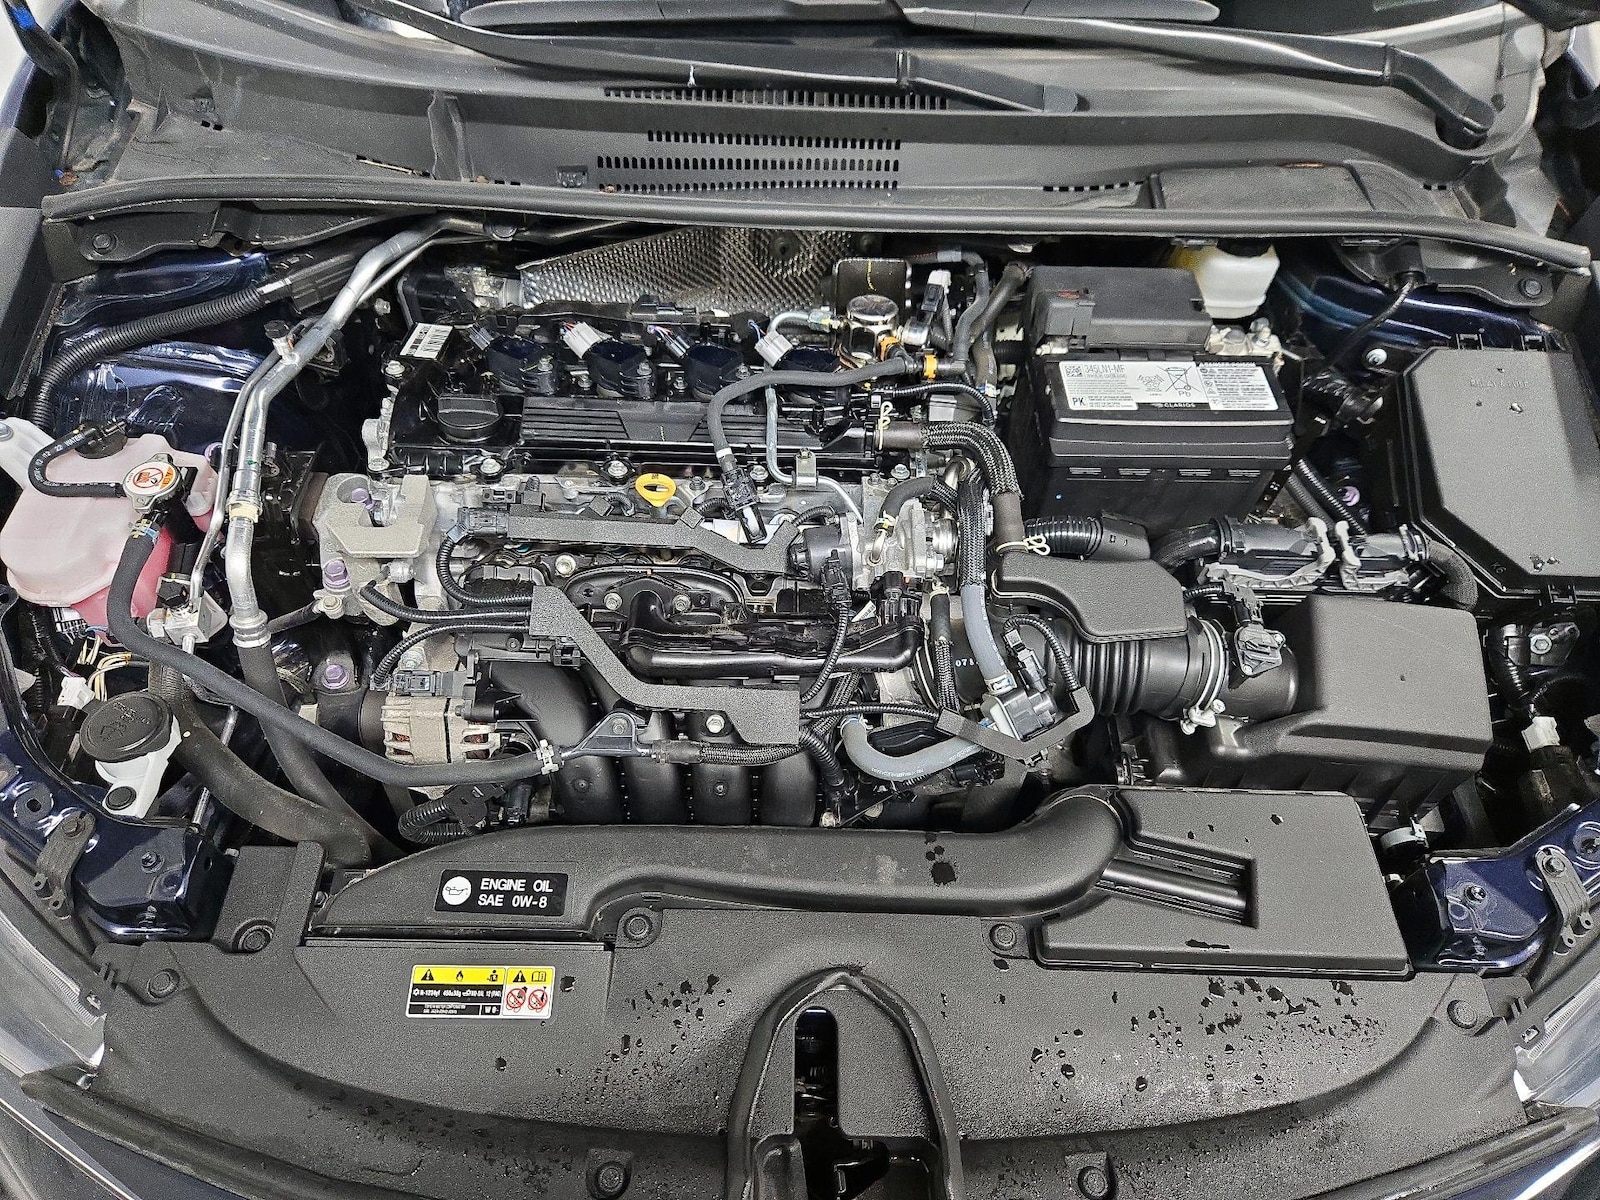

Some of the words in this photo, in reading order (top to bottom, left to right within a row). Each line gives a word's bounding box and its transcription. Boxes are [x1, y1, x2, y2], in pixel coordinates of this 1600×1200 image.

[1178, 390, 1192, 398] Pb
[1072, 397, 1086, 407] PK
[64, 433, 84, 446] WATER
[480, 878, 526, 891] ENGINE
[533, 879, 553, 893] OIL
[478, 894, 504, 906] SAE
[512, 895, 547, 908] 0W-8
